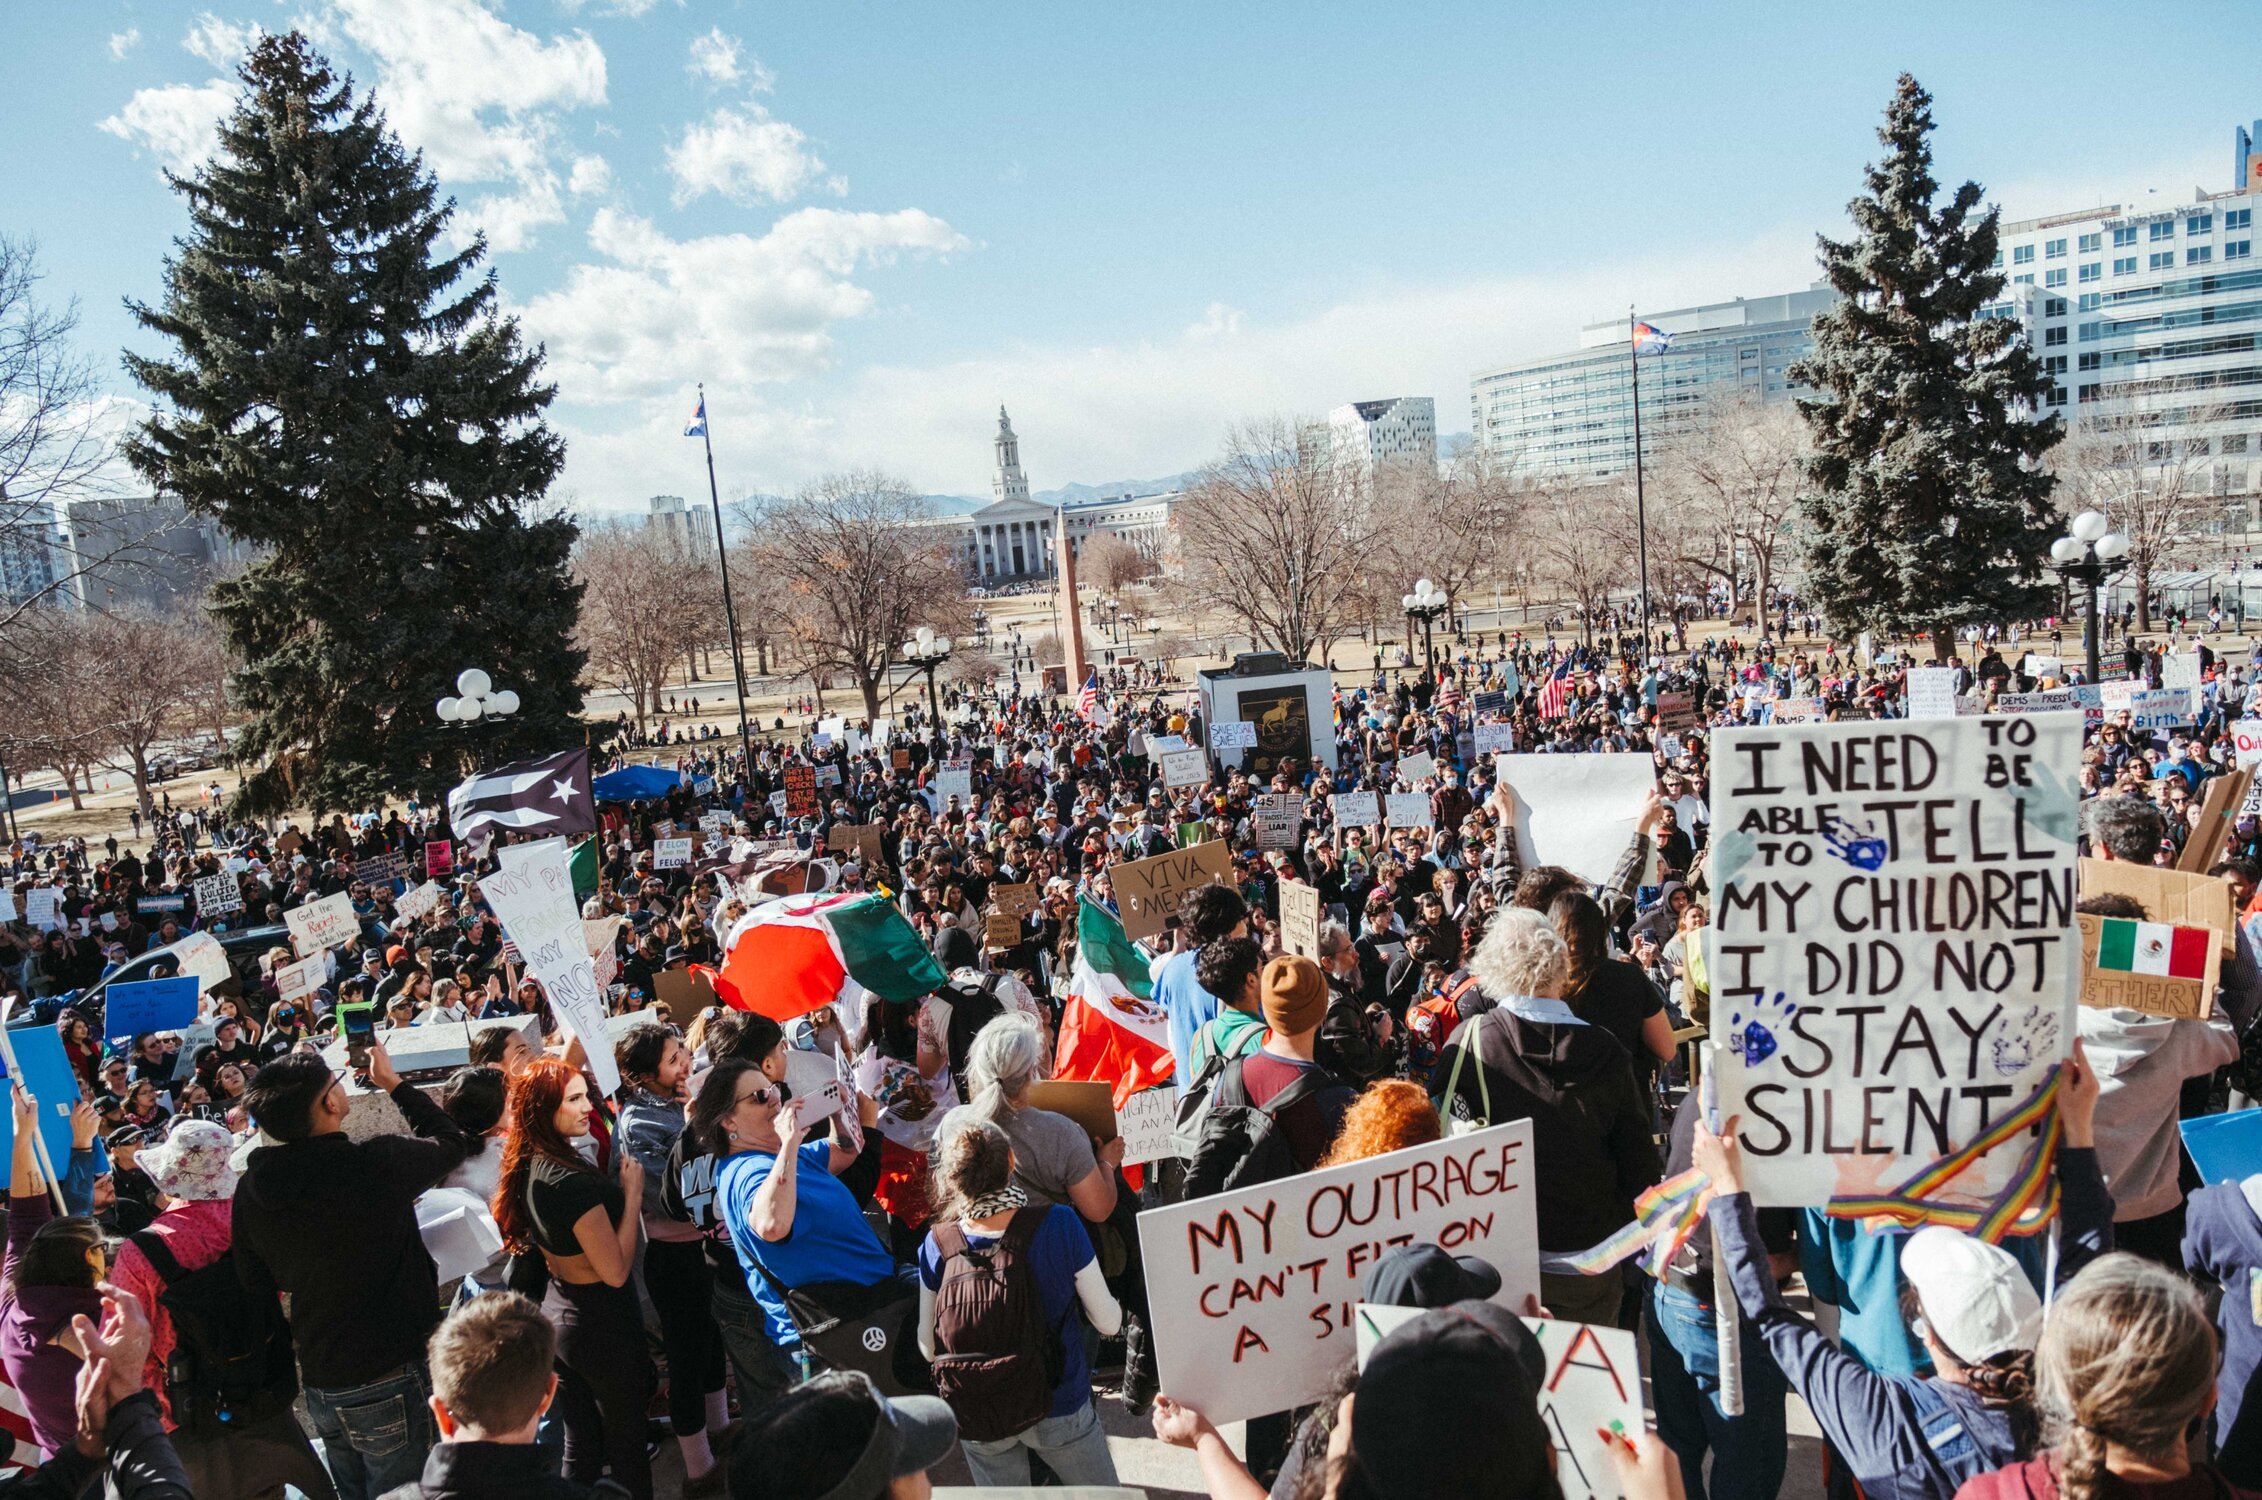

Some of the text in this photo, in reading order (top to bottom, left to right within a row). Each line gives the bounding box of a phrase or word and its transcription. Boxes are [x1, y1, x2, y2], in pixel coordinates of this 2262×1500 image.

[2001, 696, 2028, 705] DEMS
[2132, 692, 2147, 700] WE
[1476, 724, 1509, 737] DISSENT
[1776, 715, 1806, 725] DUMP
[1980, 719, 2036, 747] TO
[2136, 713, 2178, 728] Birth
[1731, 734, 1939, 797] I NEED
[1984, 753, 2034, 788] BE
[1395, 813, 1419, 826] SIN
[1737, 802, 1841, 836] ABLE
[1862, 799, 2056, 865] TELL
[660, 858, 687, 867] FELON
[1757, 840, 1814, 868] TO
[201, 879, 230, 892] NOT BE
[210, 873, 232, 881] WILL
[486, 862, 532, 903] MY
[1137, 856, 1207, 890] VIVA
[297, 908, 315, 922] Get
[1143, 886, 1195, 919] MEX
[1715, 867, 2074, 935] MY CHILDREN
[531, 938, 564, 970] MY
[1721, 935, 2062, 997] I DID NOT
[2083, 977, 2204, 1017] ETHER!
[1780, 1003, 2005, 1081] STAY
[1122, 1117, 1160, 1136] IS AN
[1187, 1140, 1524, 1276] MY OUTRAGE
[1199, 1257, 1329, 1319] CAN'T
[1438, 1211, 1495, 1250] ON
[1233, 1324, 1270, 1364] A
